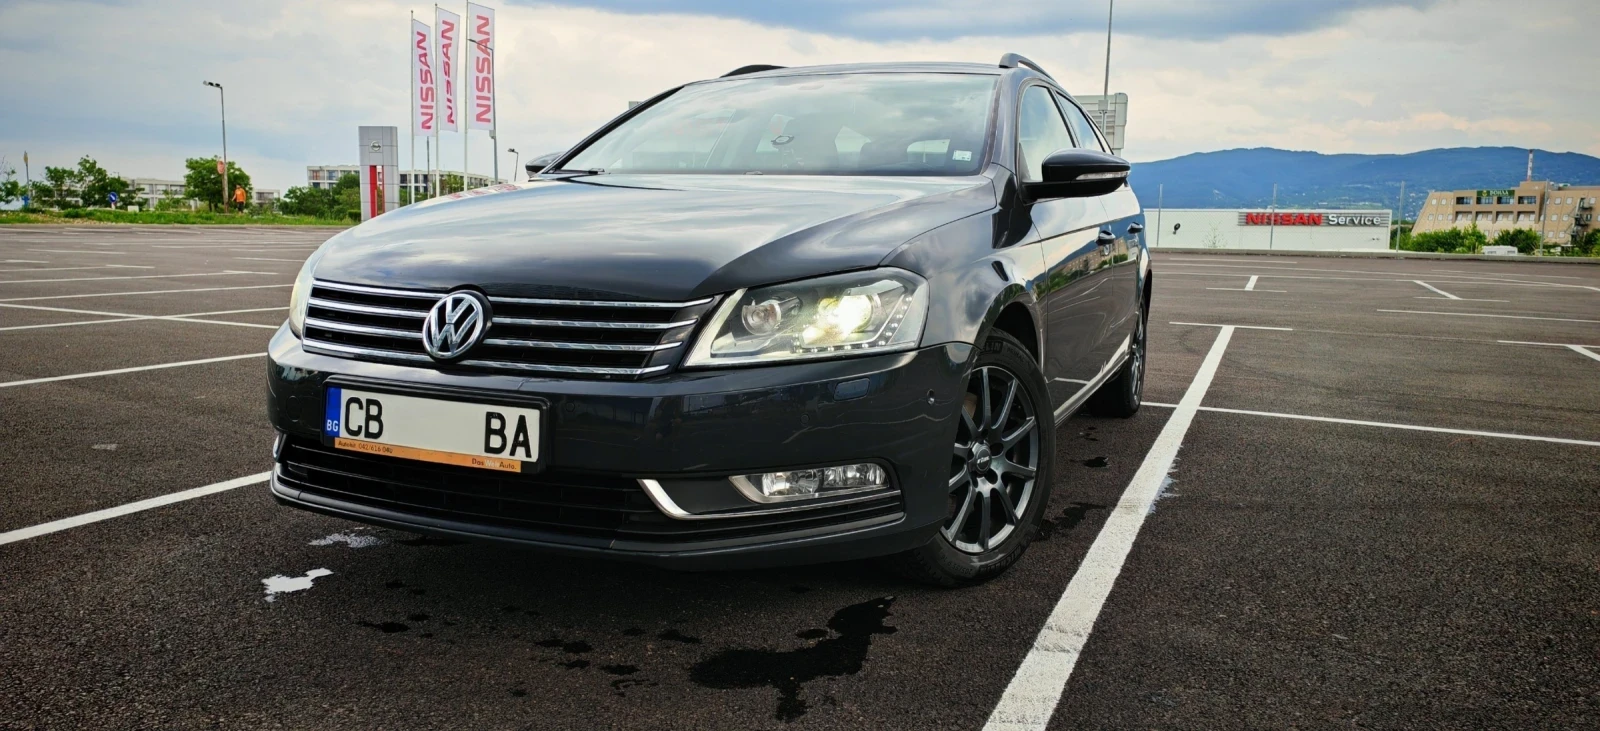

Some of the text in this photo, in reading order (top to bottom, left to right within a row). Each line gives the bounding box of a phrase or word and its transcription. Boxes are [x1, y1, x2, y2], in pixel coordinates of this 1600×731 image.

[416, 31, 435, 130] NISSAN
[441, 20, 455, 124] NISSAN
[475, 15, 491, 123] NISSAN
[1245, 212, 1381, 226] NISSAN Service
[326, 420, 339, 432] BG
[344, 396, 532, 459] CB BA
